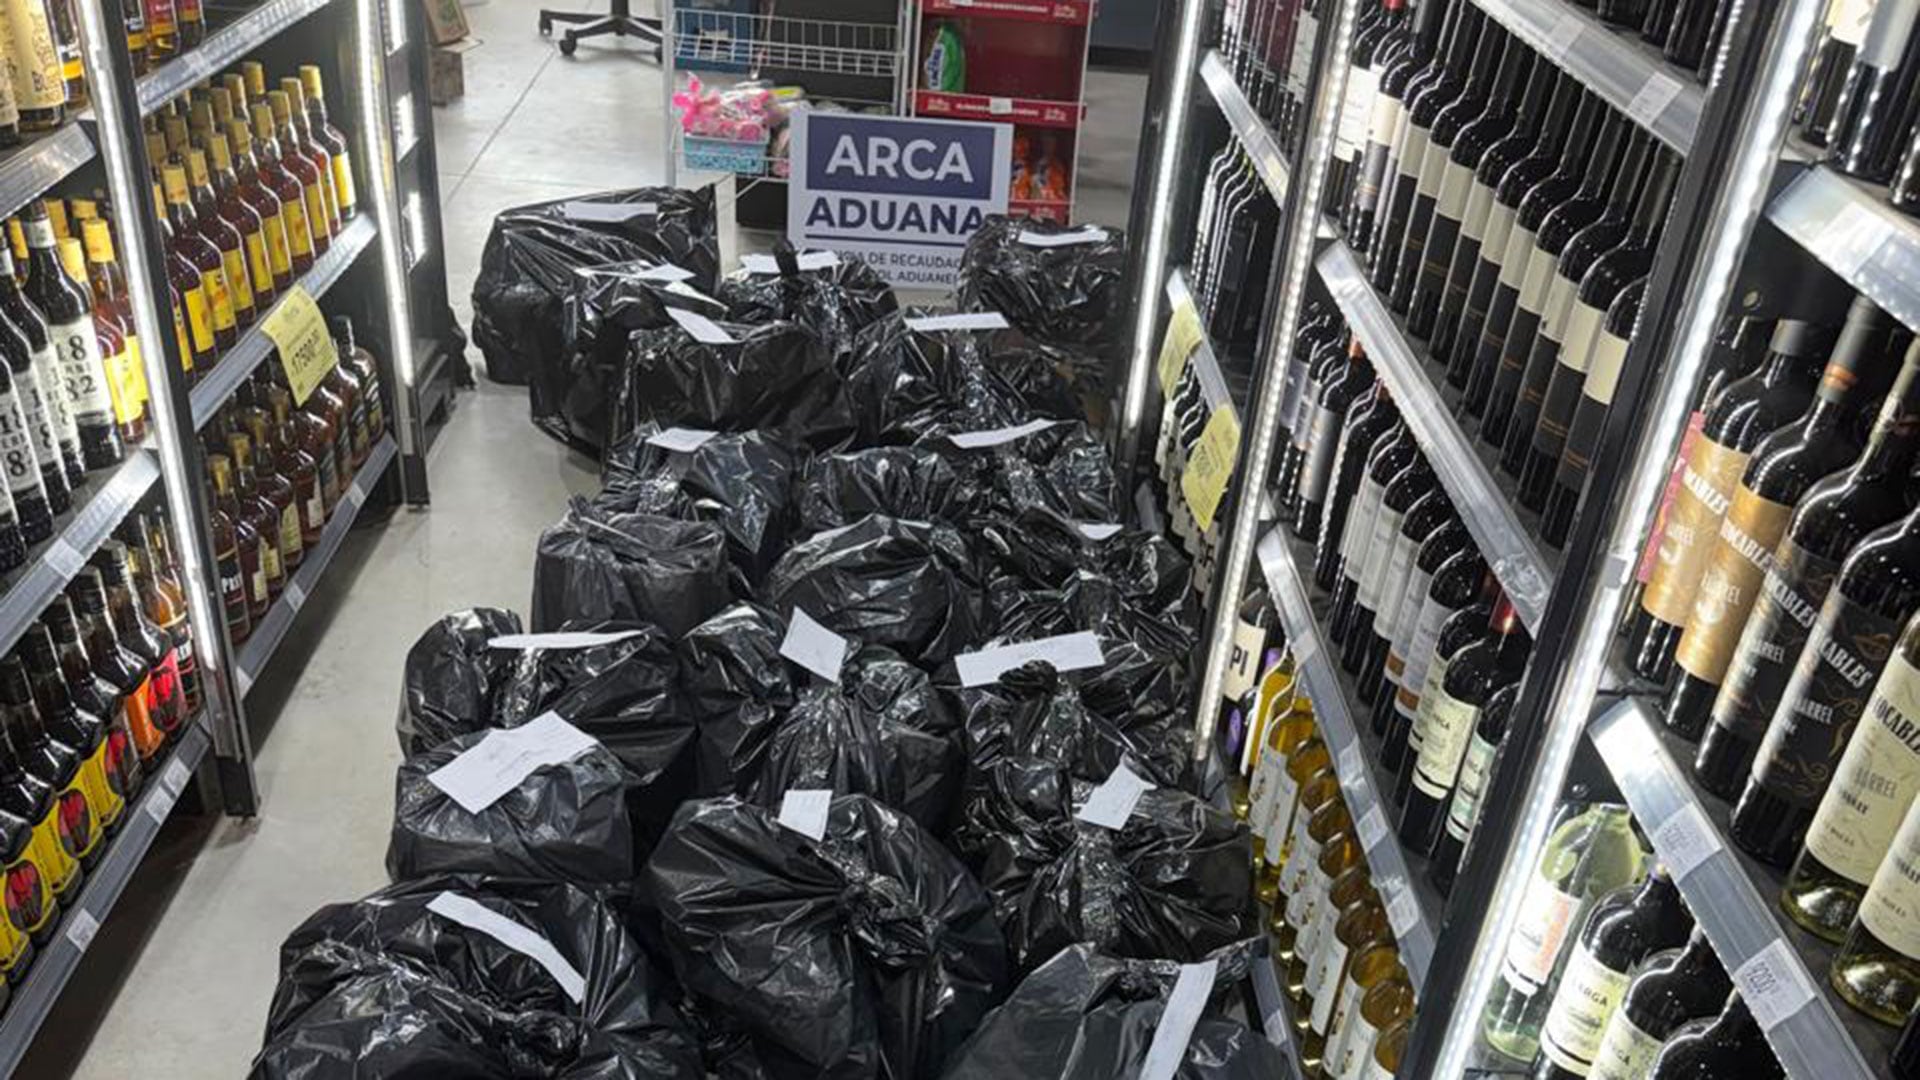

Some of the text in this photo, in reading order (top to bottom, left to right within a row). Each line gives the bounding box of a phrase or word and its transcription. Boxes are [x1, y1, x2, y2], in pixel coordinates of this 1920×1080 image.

[825, 134, 974, 183] ARCA
[805, 196, 984, 235] ADUANA
[868, 252, 888, 265] DE
